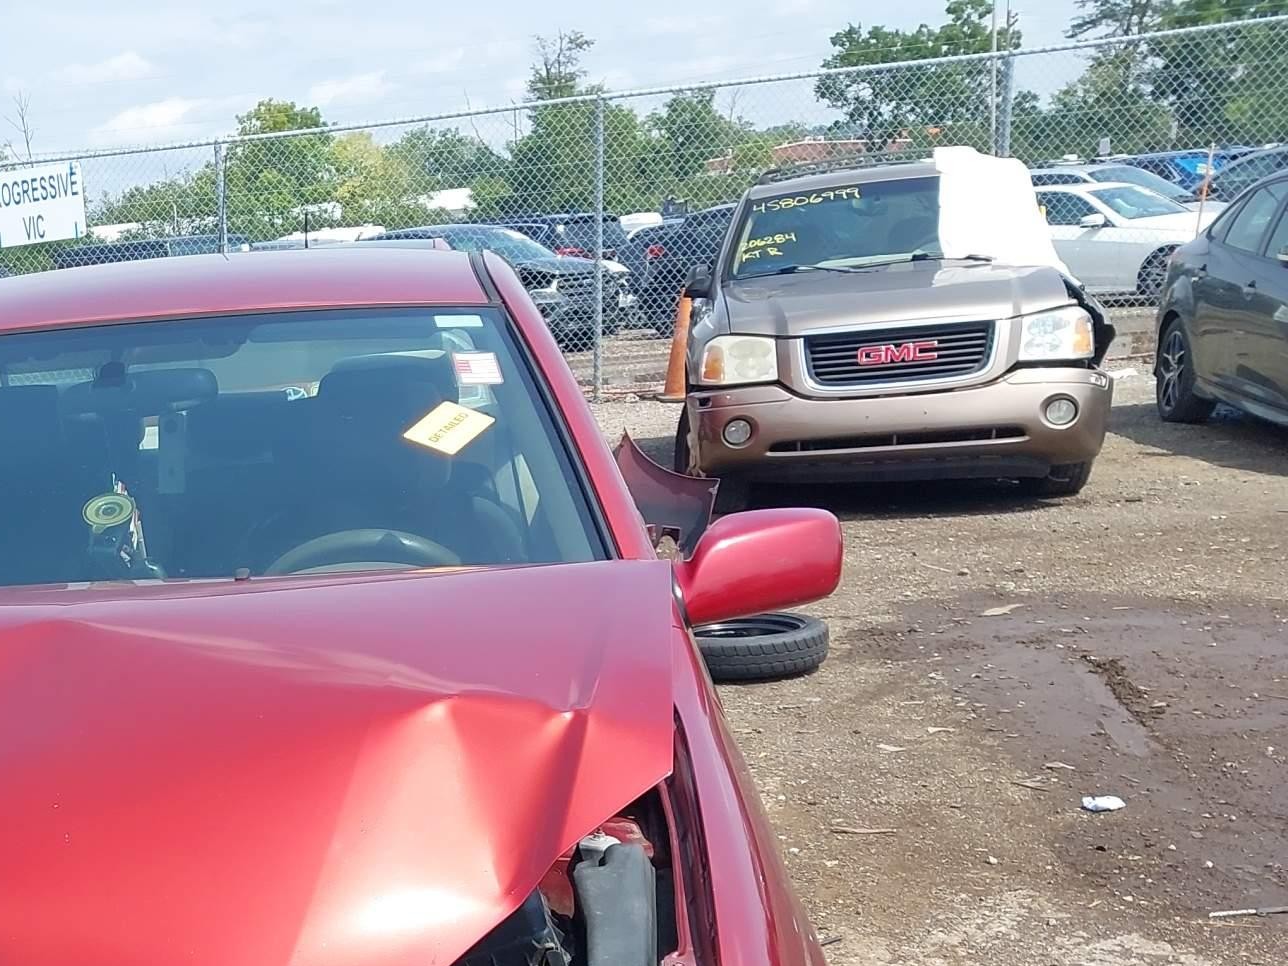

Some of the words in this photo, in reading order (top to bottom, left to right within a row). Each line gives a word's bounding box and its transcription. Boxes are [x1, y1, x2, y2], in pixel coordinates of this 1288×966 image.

[22, 215, 46, 240] VIC
[857, 341, 938, 366] GMC
[428, 412, 469, 443] DETAILED
